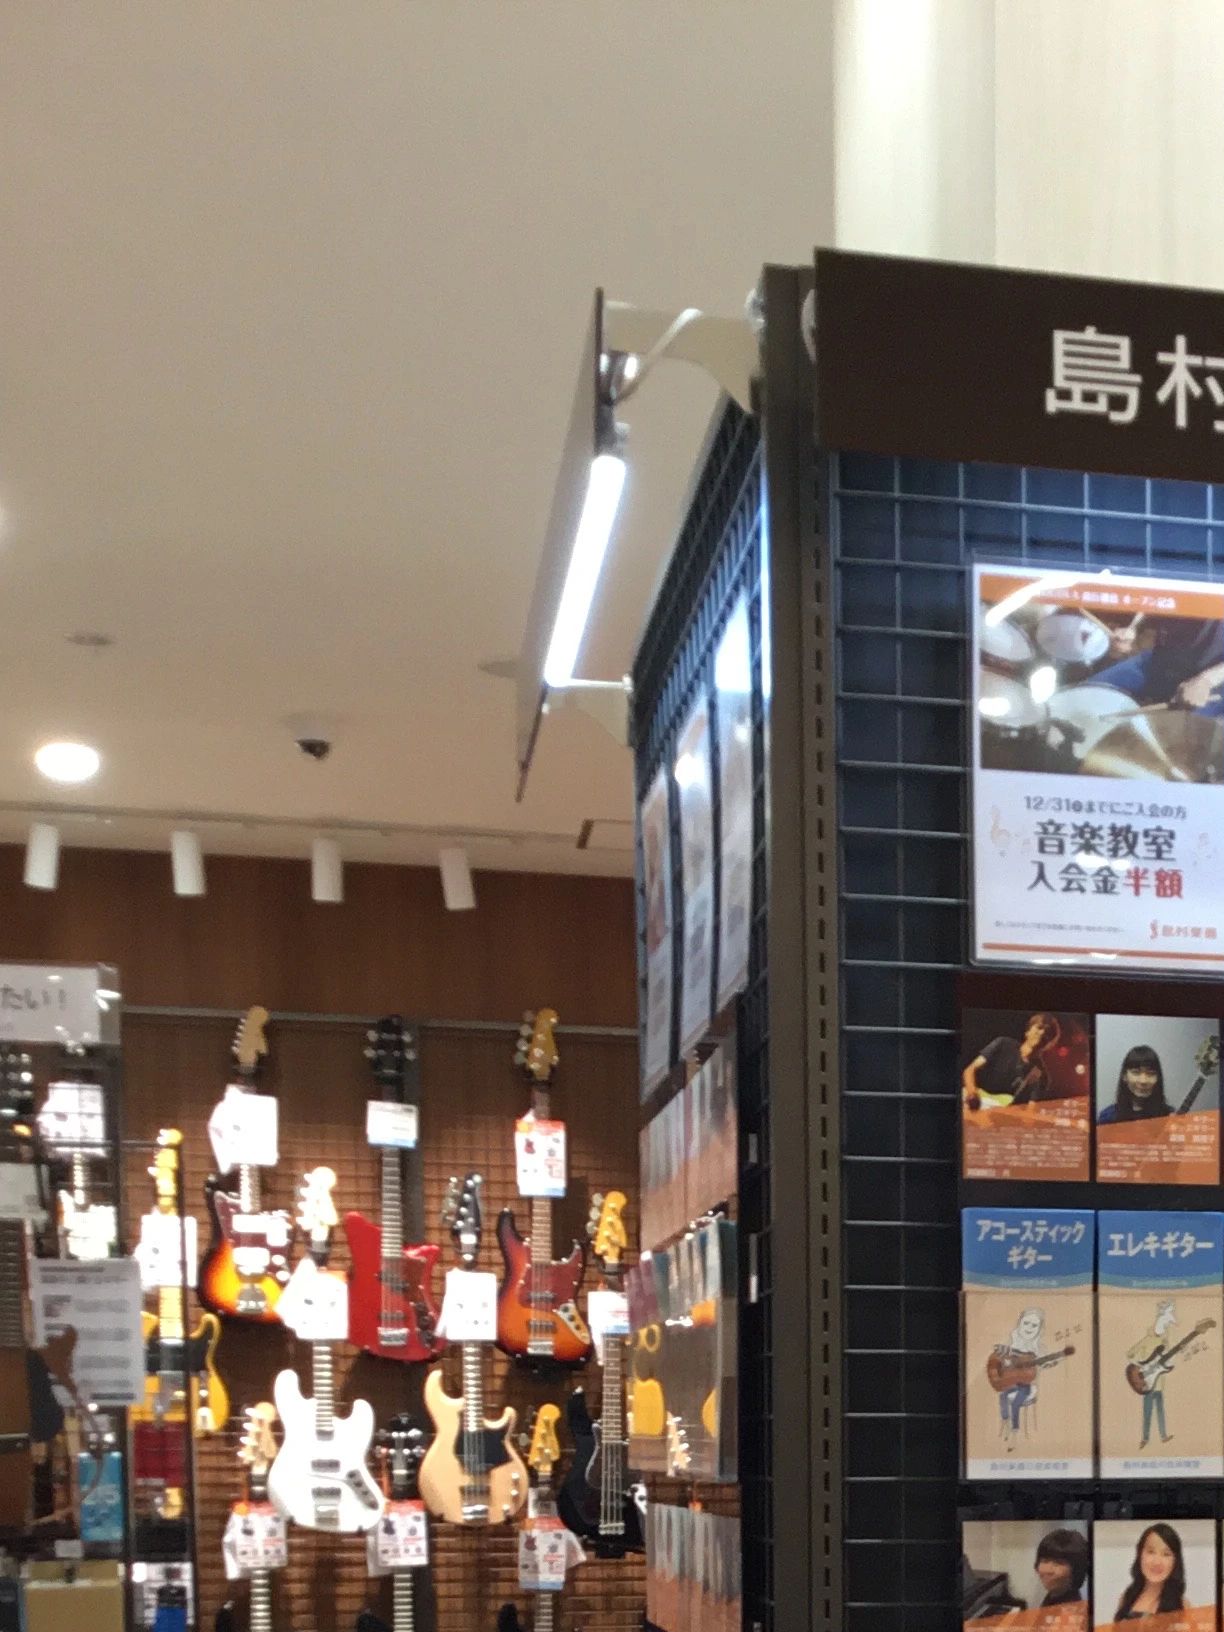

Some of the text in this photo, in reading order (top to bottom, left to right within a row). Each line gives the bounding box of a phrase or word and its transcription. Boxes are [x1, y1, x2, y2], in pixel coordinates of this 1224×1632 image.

[1034, 818, 1177, 862] 音楽教室
[976, 1218, 1086, 1245] アコースティック
[1107, 1231, 1215, 1258] エレキギター
[1008, 1245, 1053, 1269] ギター
